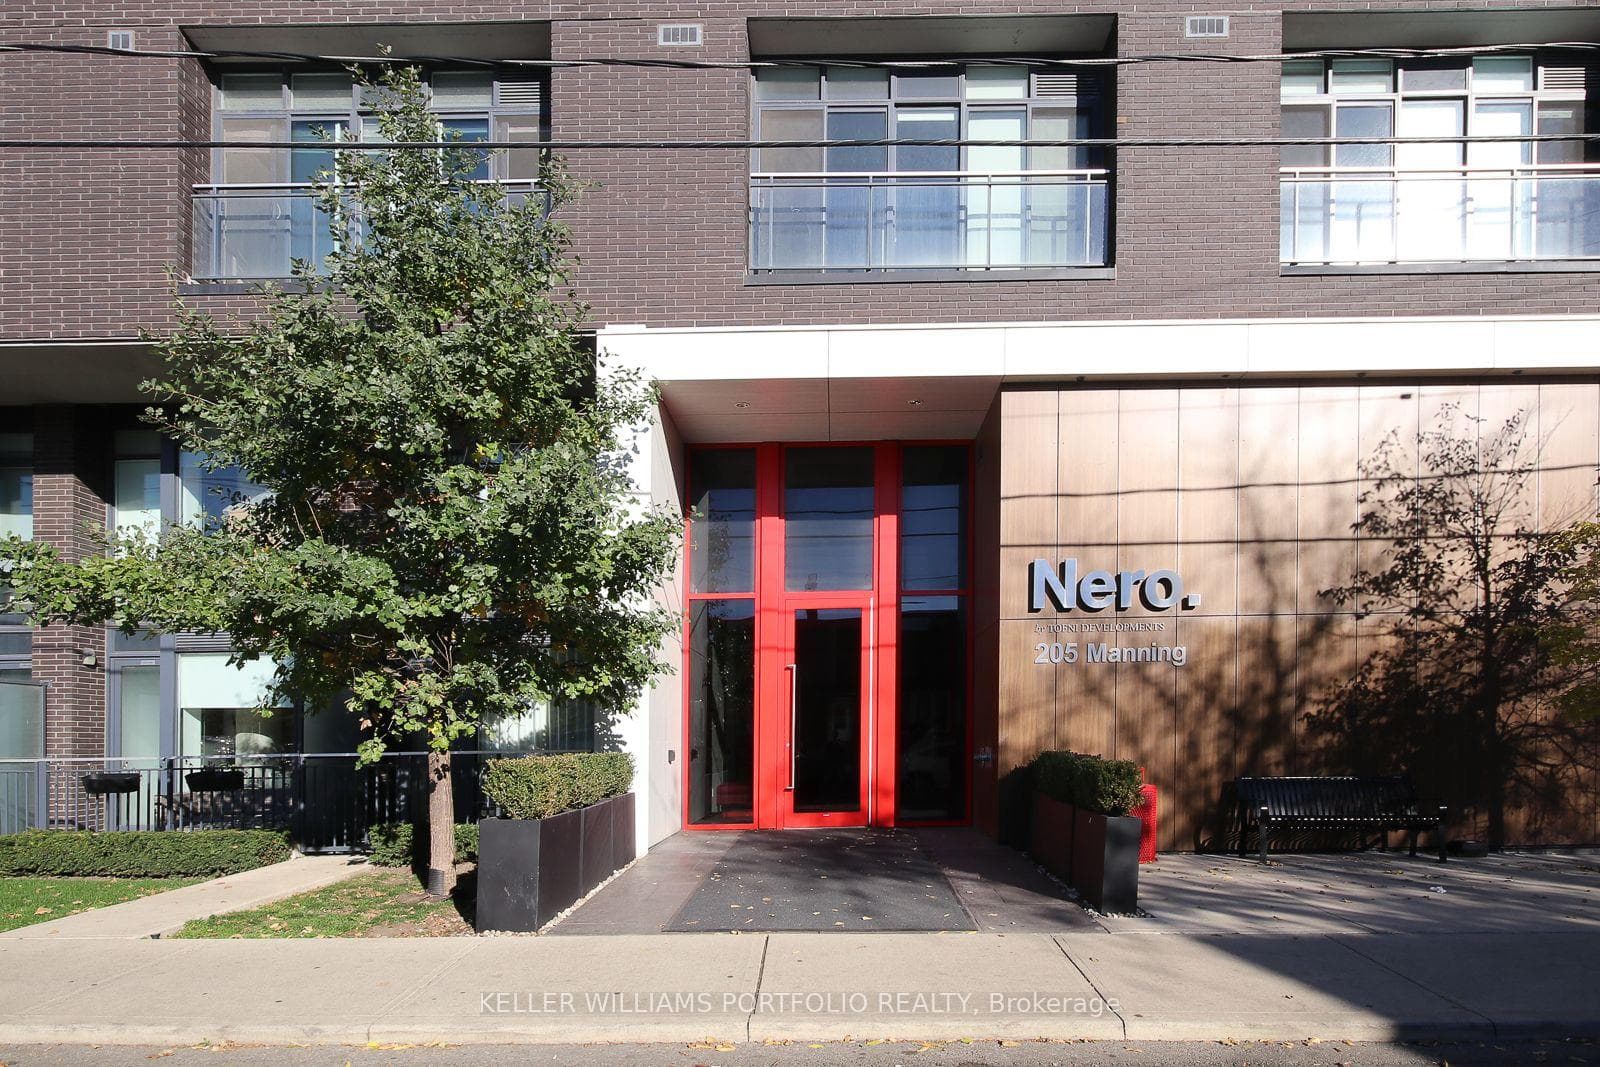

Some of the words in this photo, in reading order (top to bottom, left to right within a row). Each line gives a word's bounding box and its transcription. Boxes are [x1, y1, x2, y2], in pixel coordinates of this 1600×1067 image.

[1031, 558, 1200, 610] Nero.
[1081, 622, 1165, 632] DEVELOPMENTS
[1034, 642, 1078, 664] 205
[1087, 642, 1187, 666] Manning
